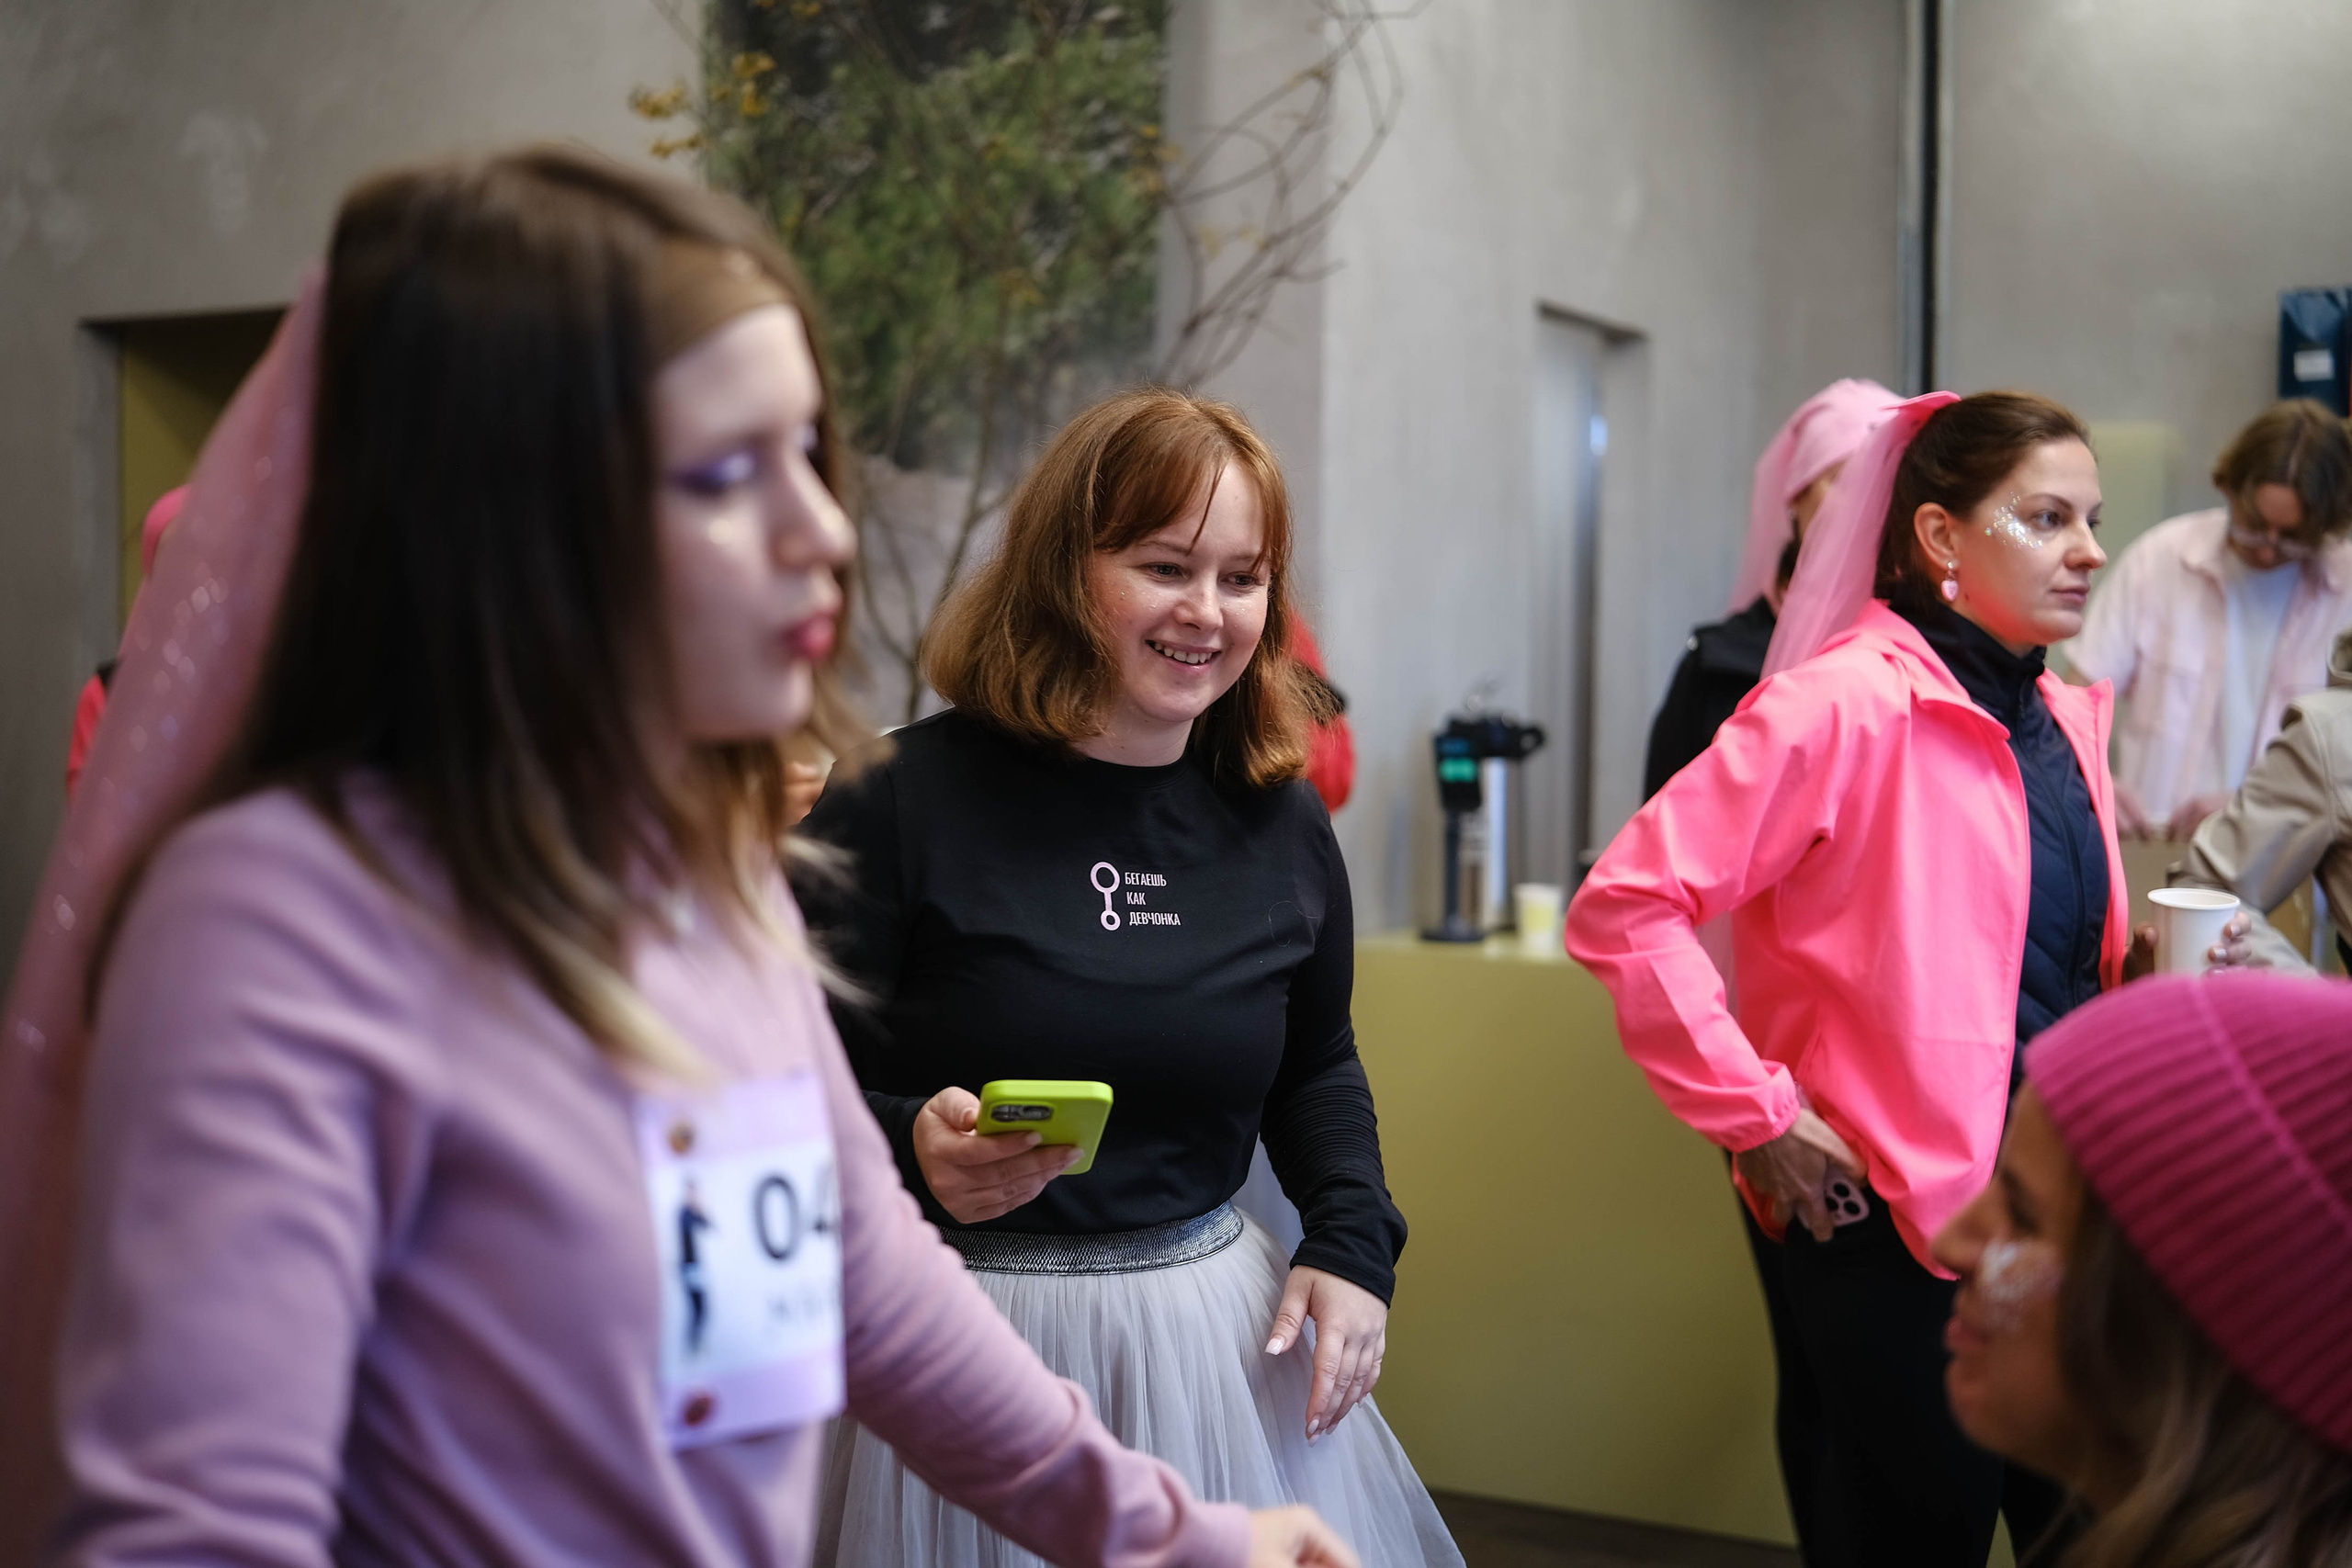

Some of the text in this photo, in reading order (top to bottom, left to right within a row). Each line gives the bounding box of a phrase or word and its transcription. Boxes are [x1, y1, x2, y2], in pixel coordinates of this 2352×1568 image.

[1125, 872, 1167, 886] БЕГАЕШЬ
[1126, 892, 1147, 905] КАК
[1129, 912, 1182, 926] ДЕВЧОНКА
